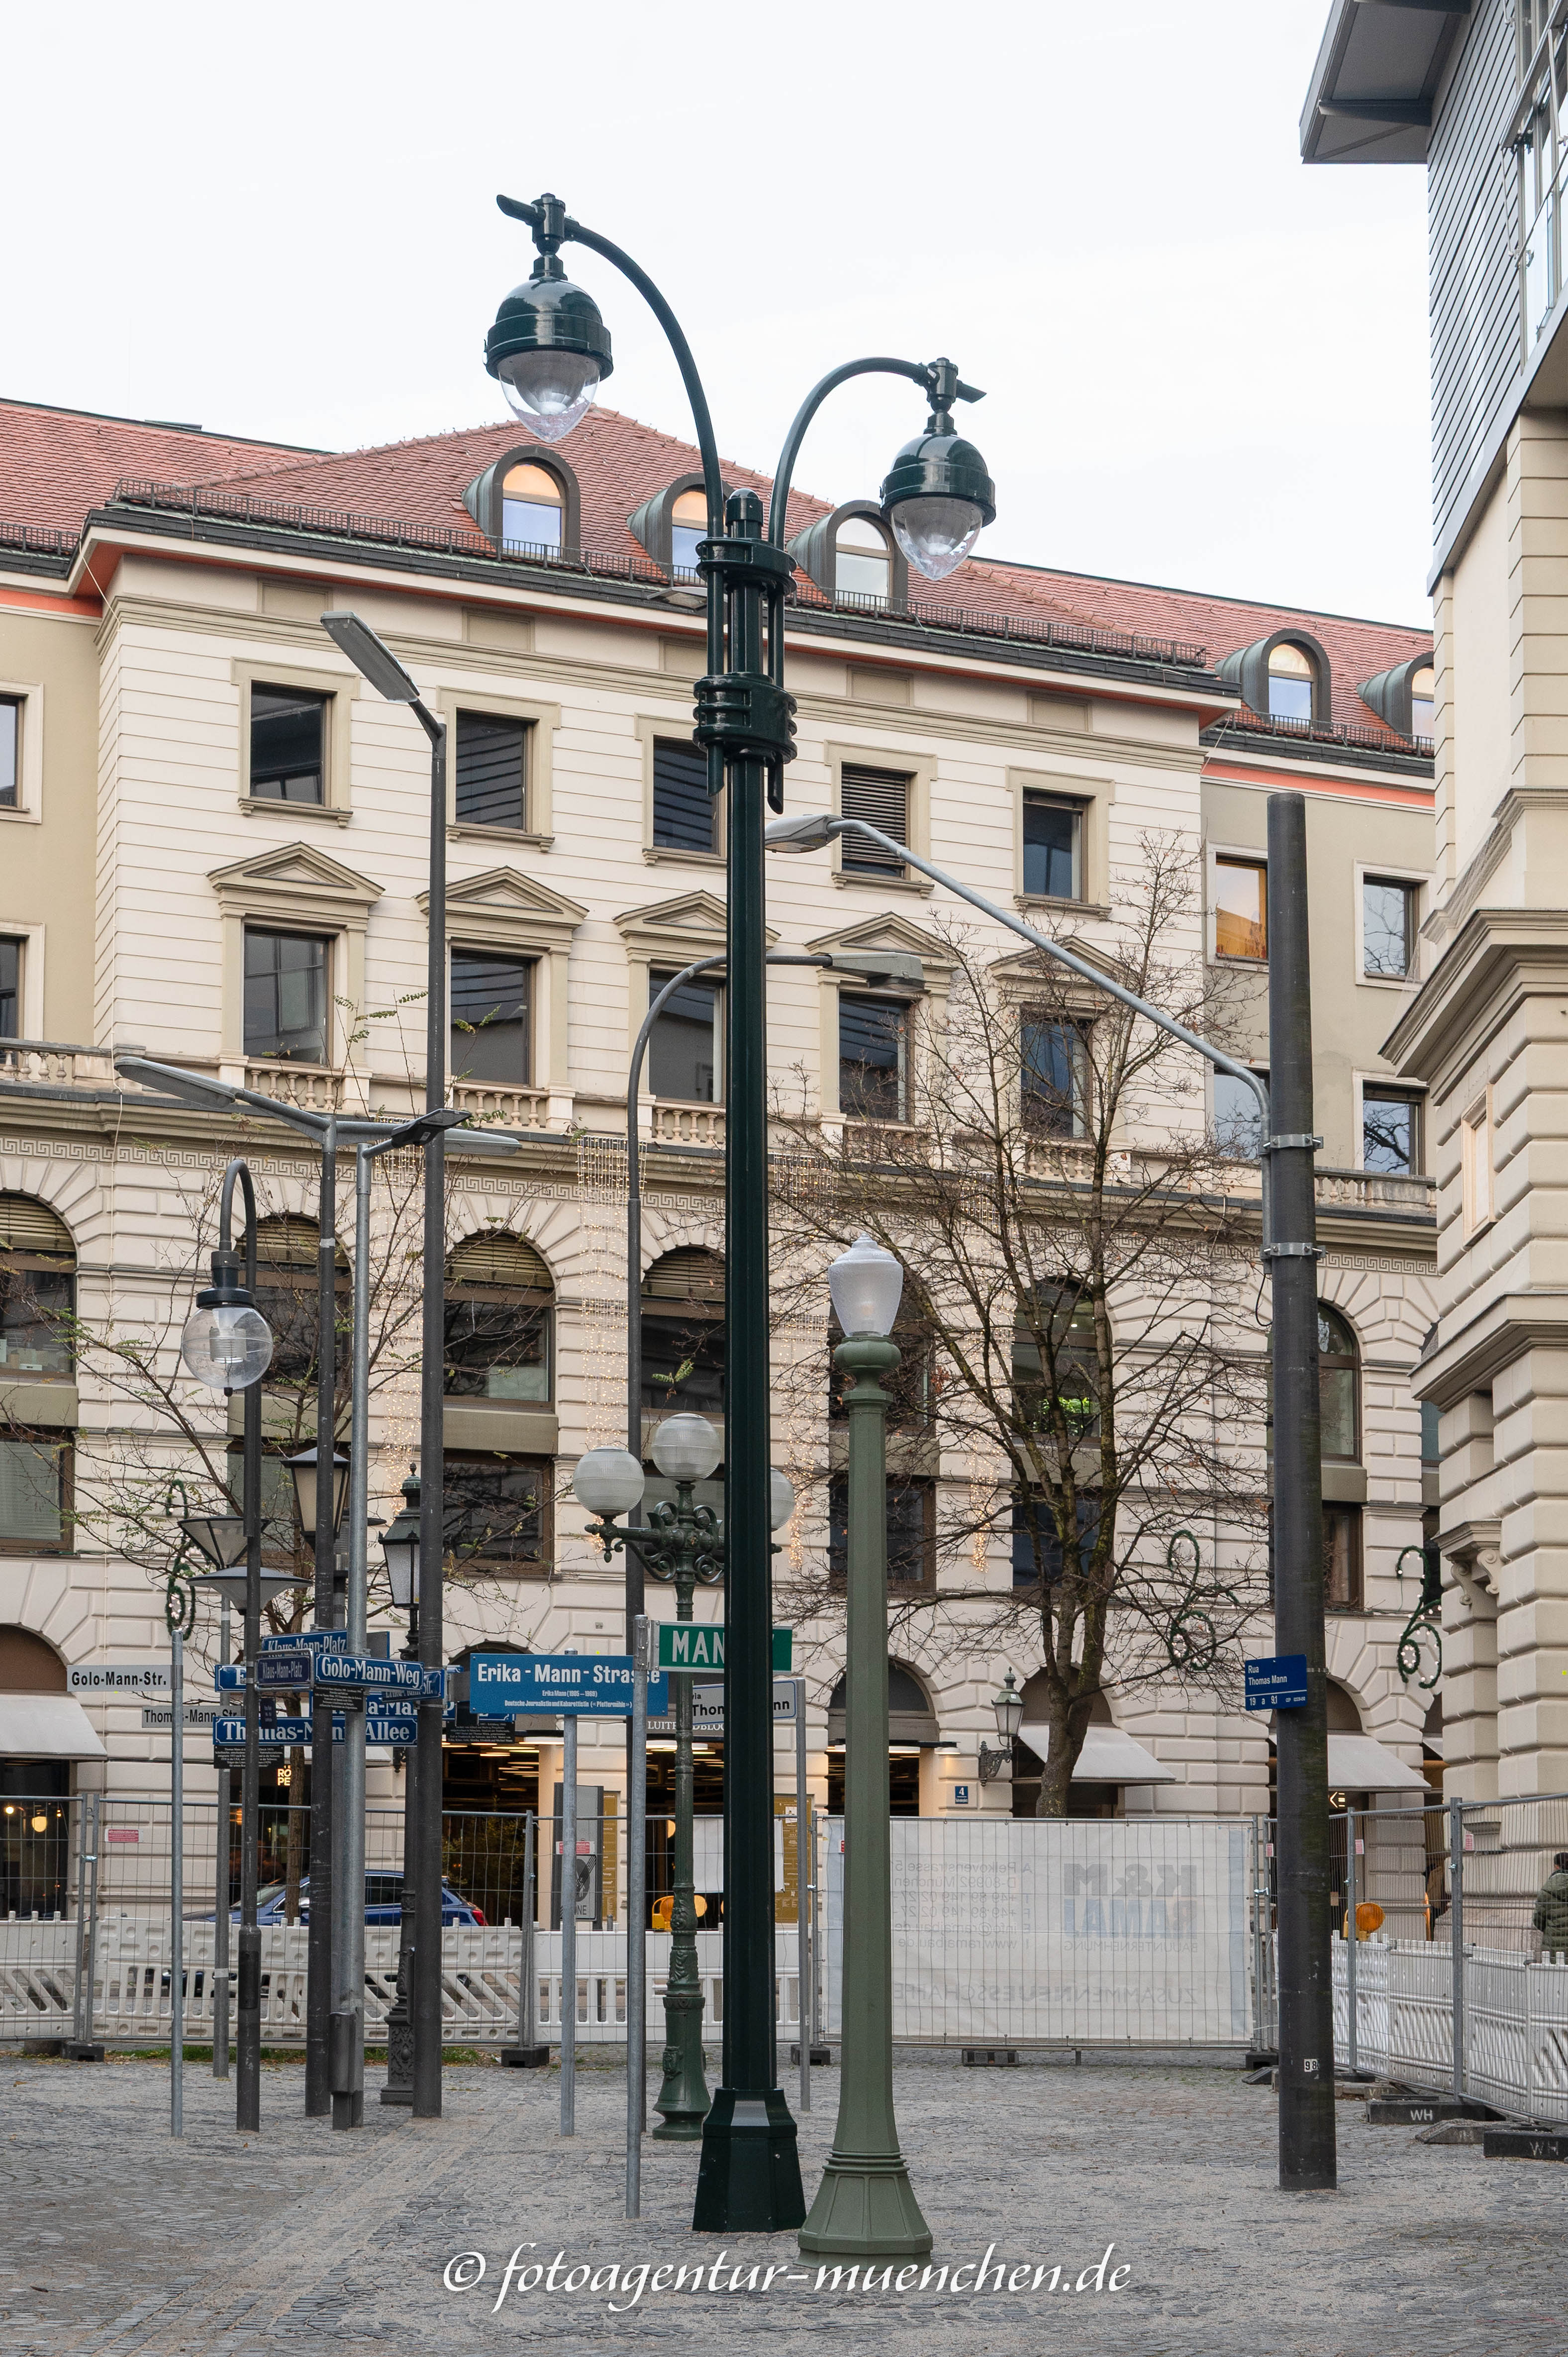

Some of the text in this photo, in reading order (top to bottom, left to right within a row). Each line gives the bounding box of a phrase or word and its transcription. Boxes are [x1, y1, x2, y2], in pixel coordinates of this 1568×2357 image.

[268, 1635, 347, 1656] Klaus-Mann-Platz
[263, 1661, 302, 1679] Klaus-Mann-Platz
[321, 1656, 420, 1688] Golo-Mann-Weg
[1248, 1665, 1259, 1673] Rua
[72, 1671, 167, 1685] Golo-Mann-Str.
[1248, 1675, 1287, 1685] Thomas Mann
[774, 1701, 789, 1710] nn
[1249, 1697, 1256, 1706] 19
[959, 1787, 964, 1795] 4
[577, 1905, 587, 1915] NE
[1410, 2109, 1433, 2121] WH
[1529, 2141, 1559, 2156] WH
